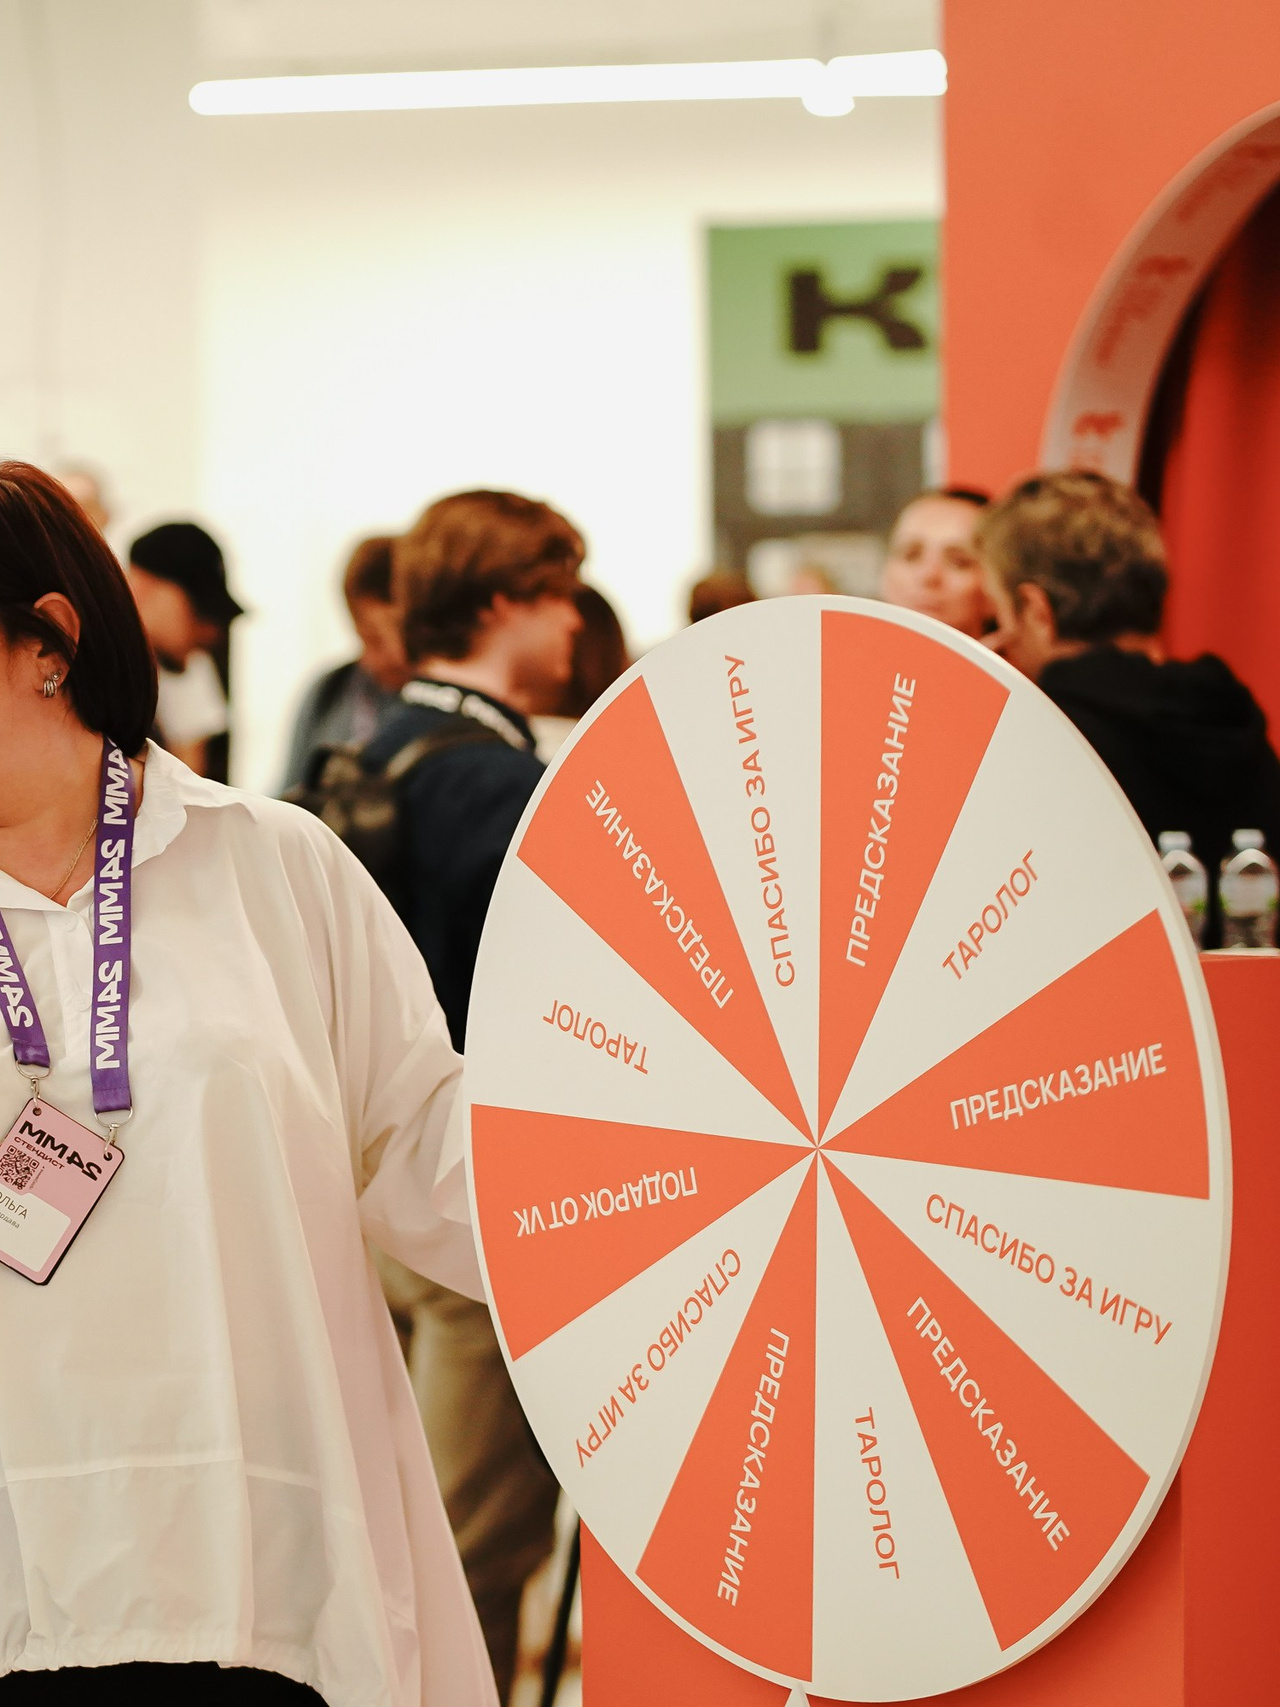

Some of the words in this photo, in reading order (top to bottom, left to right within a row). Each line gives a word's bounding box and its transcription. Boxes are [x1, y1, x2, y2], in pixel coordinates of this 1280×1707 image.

[725, 655, 757, 744] ИГРУ
[742, 750, 766, 797] ЗА
[845, 672, 917, 967] ПРЕДСКАЗАНИЕ
[585, 779, 734, 1009] ПРЕДСКАЗАНИЕ
[751, 806, 795, 987] СПАСИБО
[942, 850, 1037, 979] ТАРОЛОГ
[542, 1000, 648, 1075] ТАРОЛОГ
[949, 1043, 1167, 1130] ПРЕДСКАЗАНИЕ
[13, 1136, 66, 1170] СТЕНДИСТ
[579, 1166, 699, 1221] ПОДАРОК
[512, 1205, 547, 1238] VK
[548, 1196, 579, 1230] ОТ
[646, 1248, 741, 1372] СПАСИБО
[926, 1194, 1055, 1284] СПАСИБО
[1059, 1266, 1093, 1308] ЗА
[1099, 1287, 1172, 1345] ИГРУ
[617, 1363, 649, 1404] ЗА
[906, 1296, 1070, 1551] ПРЕДСКАЗАНИЕ
[576, 1395, 625, 1468] ИГРУ
[717, 1327, 790, 1607] ПРЕДСКАЗАНИЕ
[855, 1407, 900, 1579] ТАРОЛОГ
